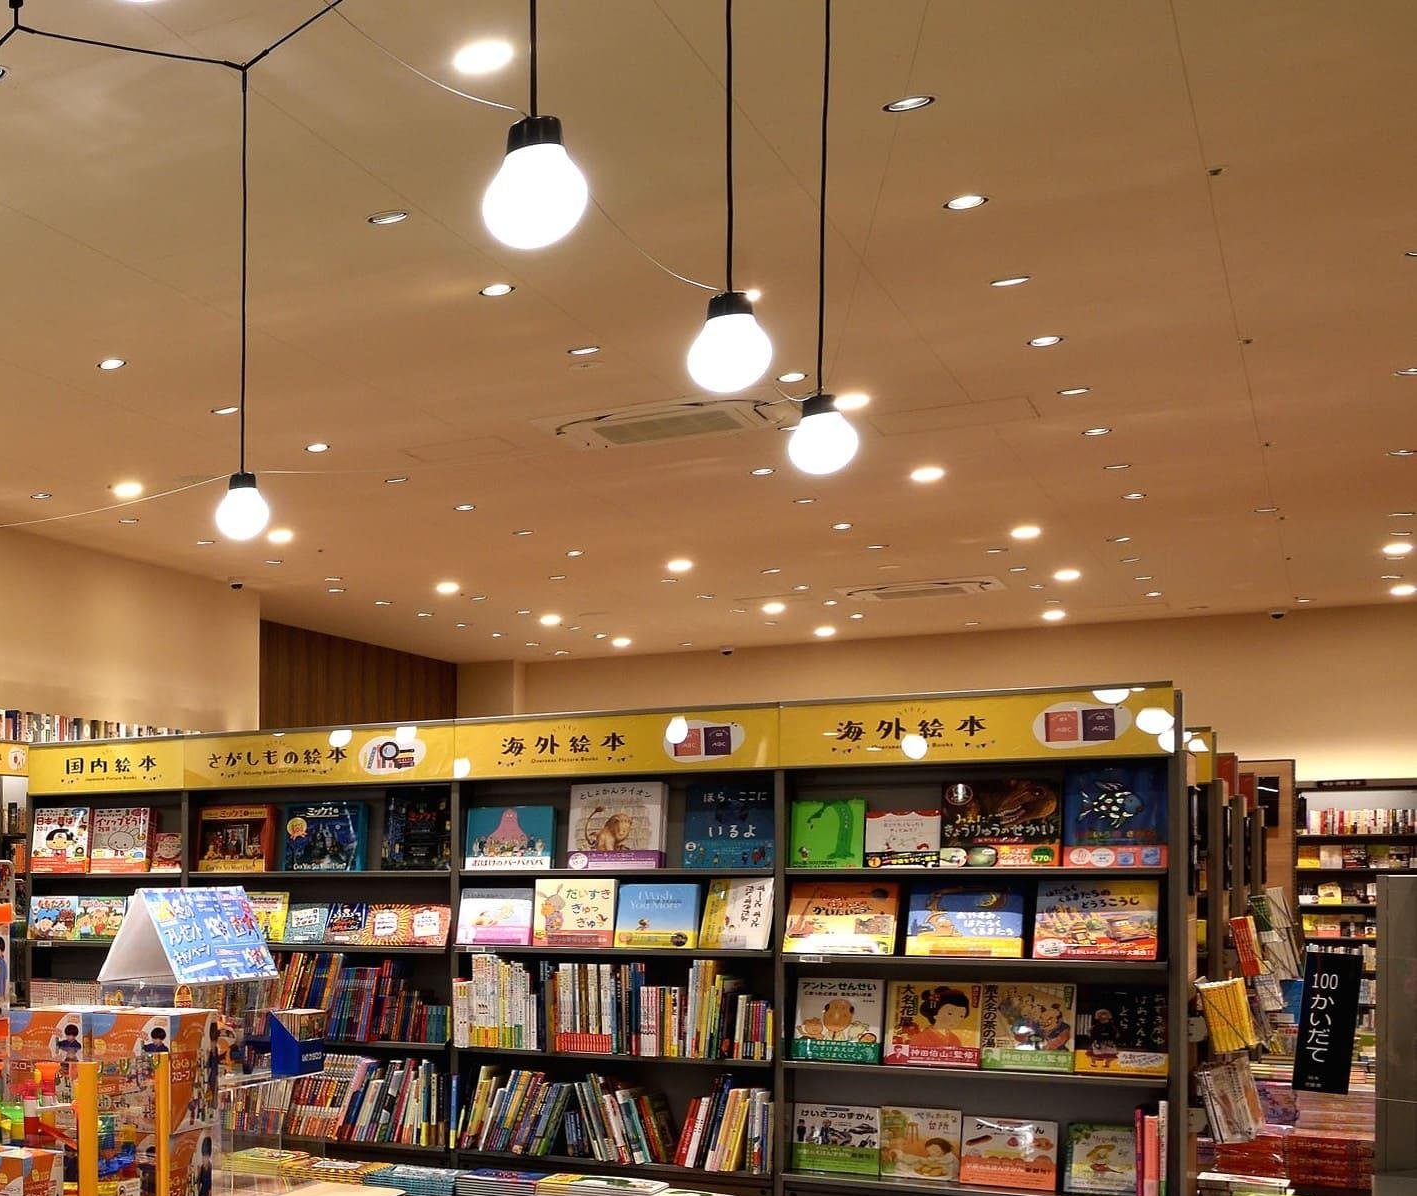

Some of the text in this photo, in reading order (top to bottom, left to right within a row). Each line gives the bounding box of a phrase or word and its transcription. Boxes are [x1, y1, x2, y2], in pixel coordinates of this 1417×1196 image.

[836, 714, 986, 742] 海外絵本
[501, 732, 626, 756] 海外絵本
[65, 754, 158, 776] 国内絵本
[207, 745, 348, 768] さがしもの絵本
[579, 786, 653, 800] としょかんライオン
[708, 824, 757, 838] いるよ
[565, 888, 612, 900] だいすき
[1081, 895, 1140, 909] どうろこうじ
[1304, 972, 1339, 1064] 100かいだて
